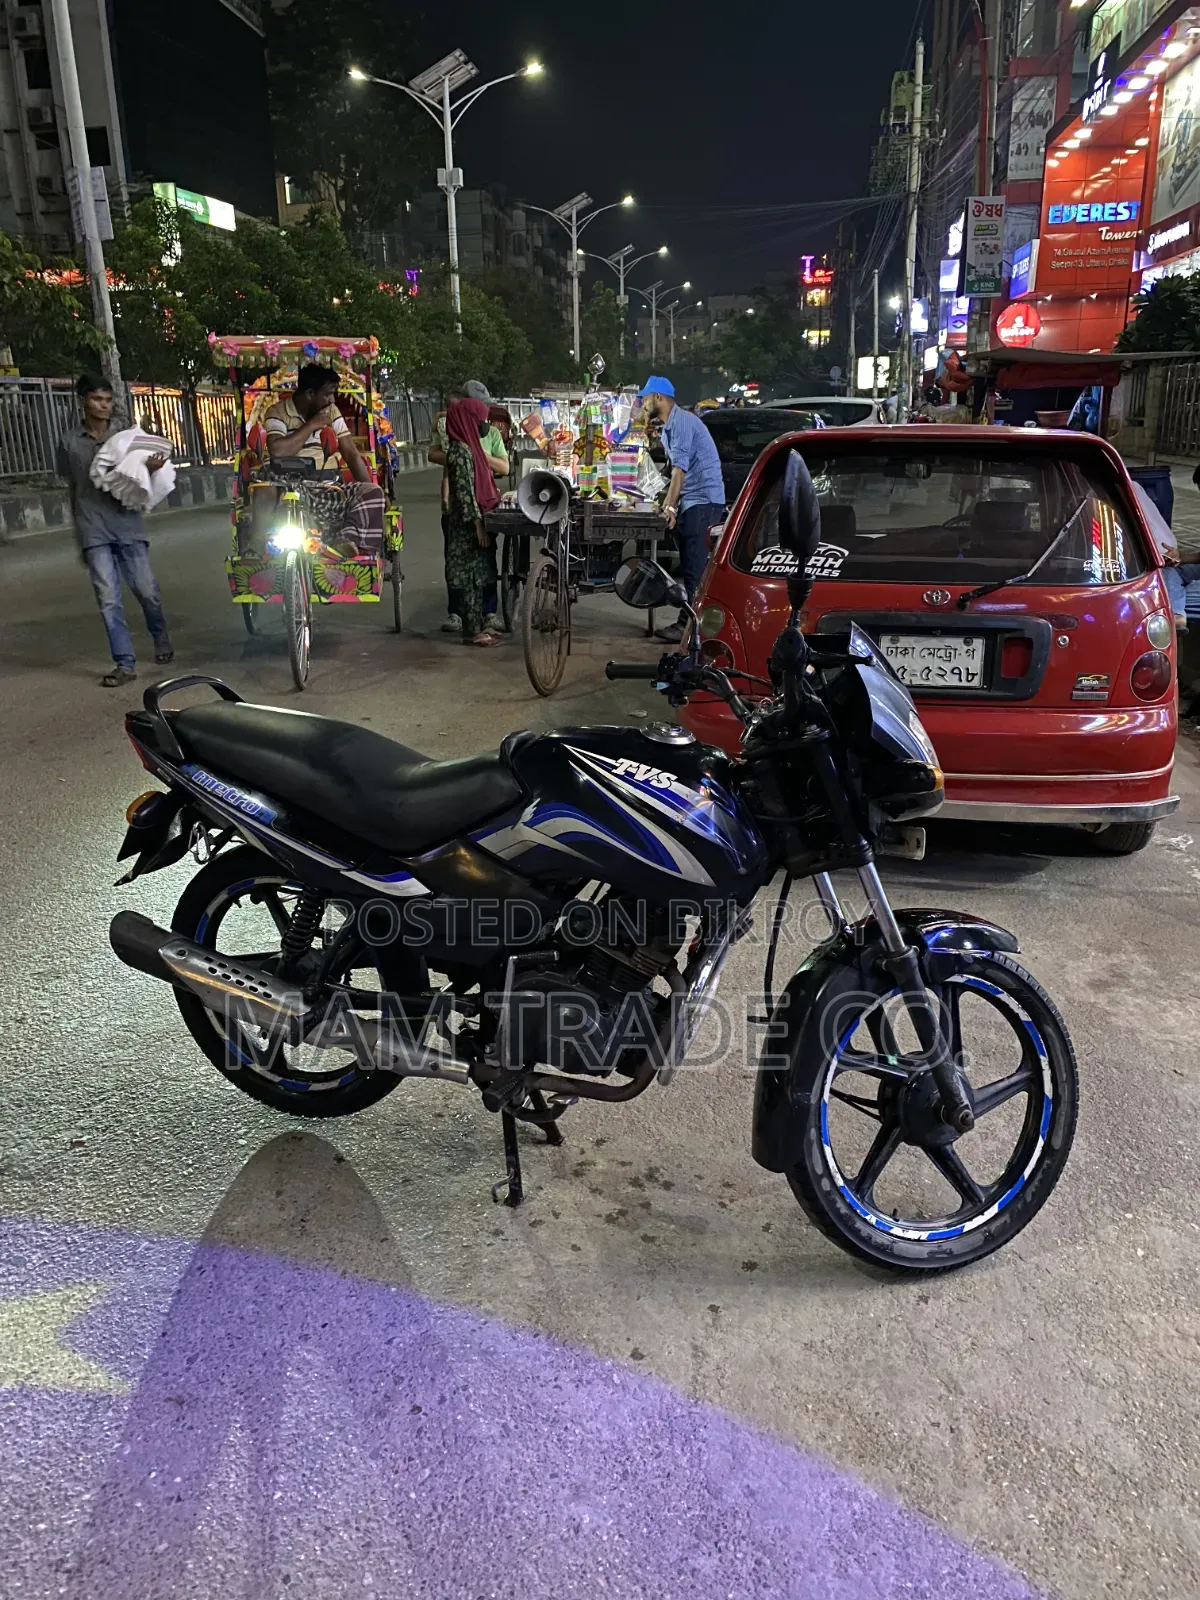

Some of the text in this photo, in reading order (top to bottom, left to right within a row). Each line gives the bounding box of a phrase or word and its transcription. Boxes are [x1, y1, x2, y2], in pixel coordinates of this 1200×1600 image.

[972, 200, 1003, 217] ঔষধ
[1048, 201, 1141, 224] EVEREST
[1098, 226, 1142, 240] Tower
[752, 554, 844, 568] MOLAH
[750, 565, 841, 577] AUTOMBILES
[886, 646, 916, 658] ঢাকা
[897, 665, 979, 683] ৫-৫২৭৮
[611, 757, 678, 789] TVS
[192, 770, 261, 815] metro
